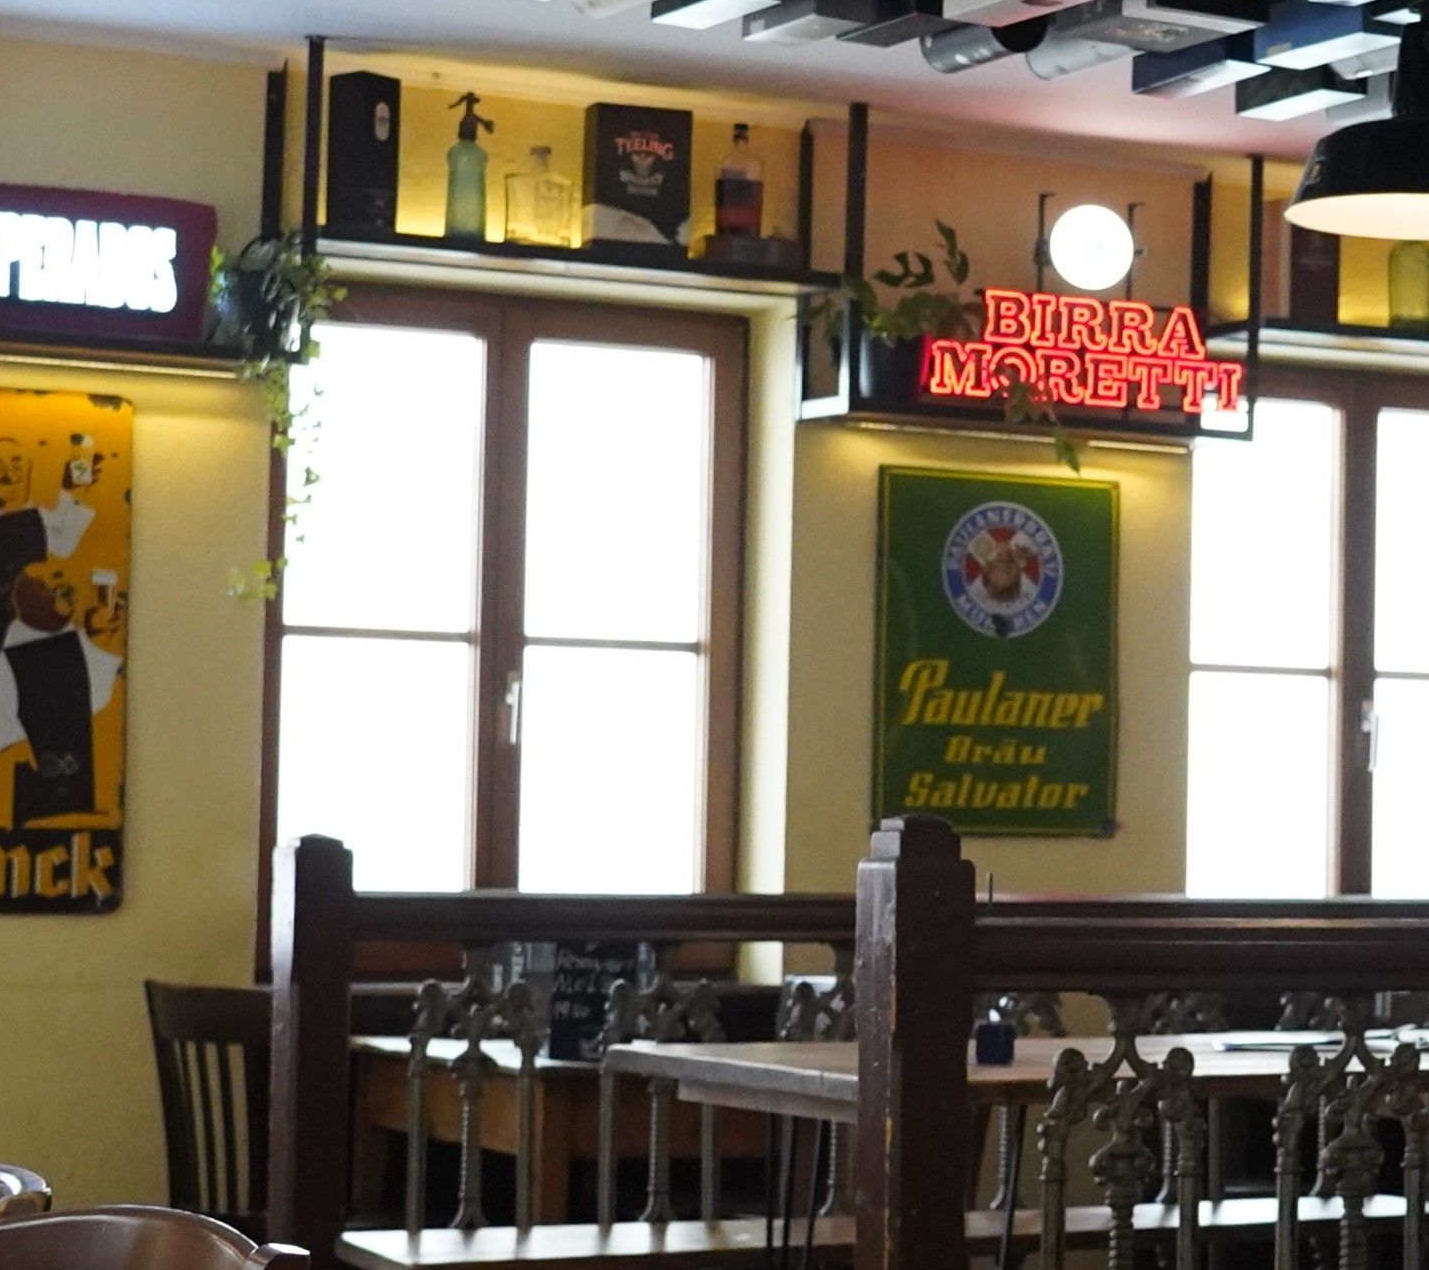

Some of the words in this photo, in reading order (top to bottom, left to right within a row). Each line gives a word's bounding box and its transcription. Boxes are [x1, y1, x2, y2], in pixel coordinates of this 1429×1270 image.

[615, 136, 675, 161] TEELING
[985, 288, 1207, 360] BIRRA
[930, 338, 1244, 412] MORETTI
[898, 658, 1105, 730] Paulaner
[945, 735, 1048, 766] Bräu
[904, 772, 1091, 810] Salvator
